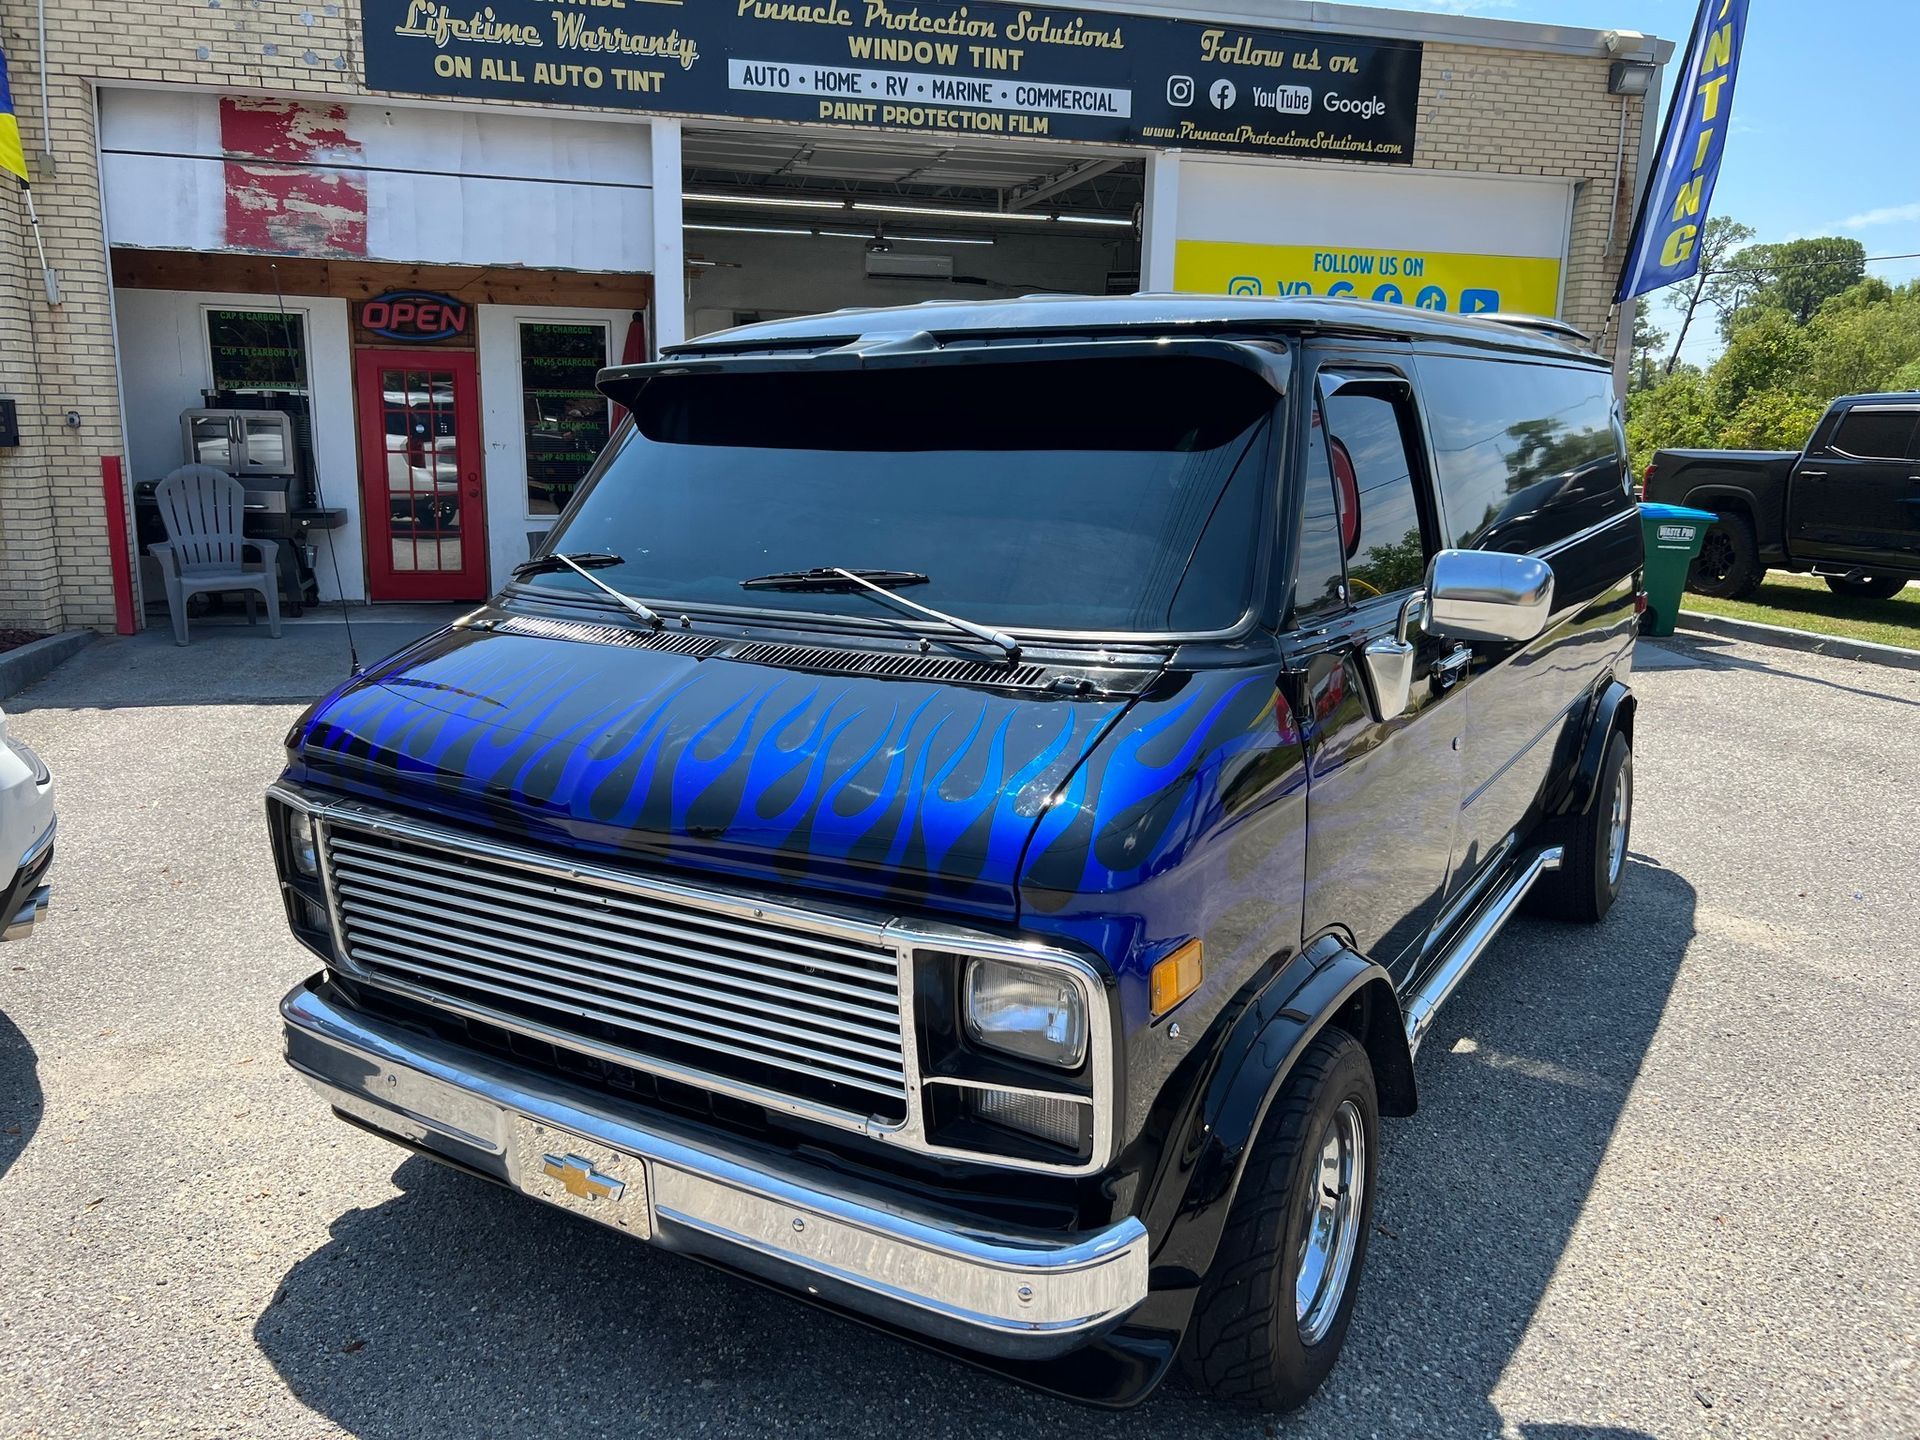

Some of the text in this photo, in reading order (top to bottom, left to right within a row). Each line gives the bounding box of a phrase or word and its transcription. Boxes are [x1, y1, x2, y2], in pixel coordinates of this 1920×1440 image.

[395, 0, 700, 70] Lifetime Warranty
[863, 0, 998, 38] Protection
[1005, 10, 1125, 49] Solutions
[848, 36, 1024, 71] WINDOW TINT
[1201, 29, 1359, 74] Follow us on
[434, 54, 666, 93] ON ALL AUTO TINT
[743, 65, 1118, 113] AUTO HOME RV MARINE COMMERCIAL
[1252, 85, 1312, 115] YouTube
[818, 100, 1049, 135] PAINT PROTECTION FILM
[1323, 91, 1386, 120] Google
[1313, 252, 1424, 277] FOLLOW US ON
[220, 311, 237, 320] CXP
[246, 312, 281, 321] CARBON
[362, 302, 466, 332] OPEN
[552, 325, 593, 335] CHARCOAL
[220, 347, 237, 356] CXP
[251, 348, 286, 357] CARBON
[557, 358, 597, 367] CHARCOAL
